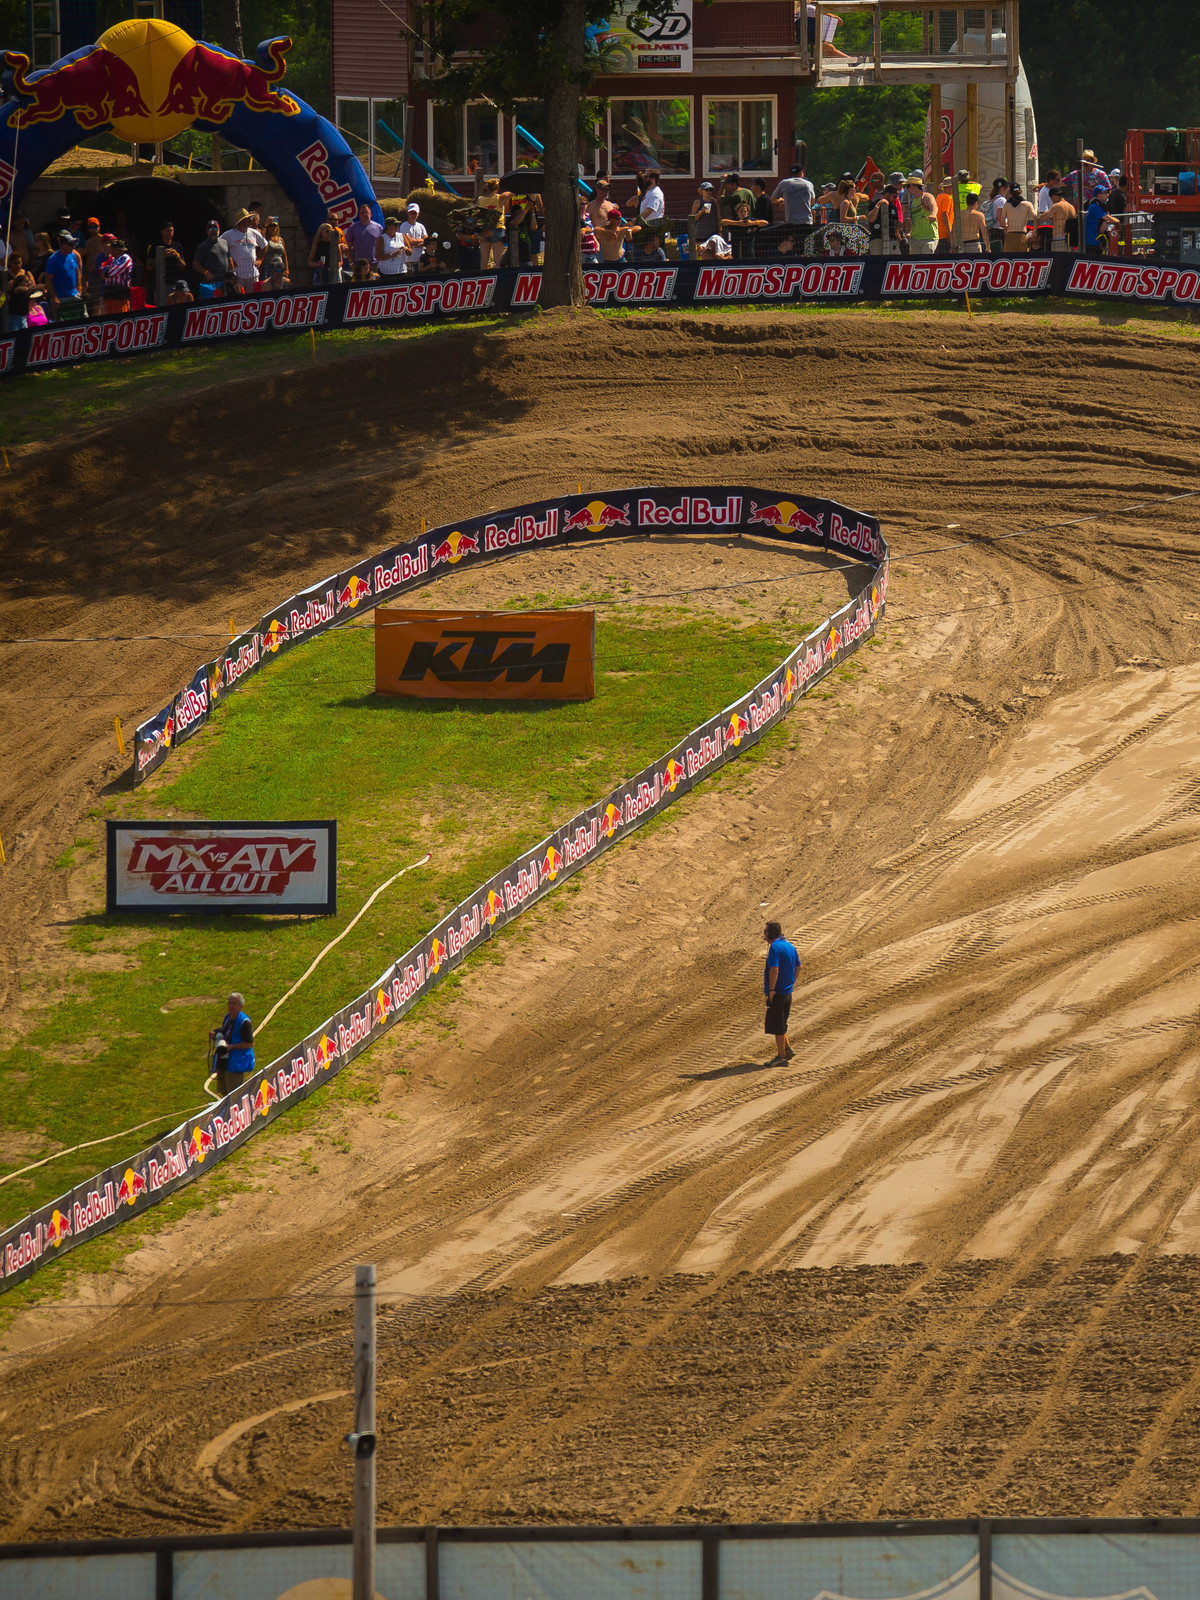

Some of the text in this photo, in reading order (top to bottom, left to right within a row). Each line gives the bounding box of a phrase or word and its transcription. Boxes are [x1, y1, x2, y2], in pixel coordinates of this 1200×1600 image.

[630, 43, 689, 51] HELMETS
[296, 140, 353, 204] Red
[1140, 197, 1176, 205] SKYJACK
[638, 496, 743, 526] Red Bull
[485, 508, 559, 552] Red Bull
[830, 513, 862, 550] Red
[374, 543, 428, 594] Red Bull
[398, 631, 571, 683] KTM
[131, 843, 217, 872] MX
[218, 842, 316, 872] ATV
[159, 873, 279, 892] ALL OUT
